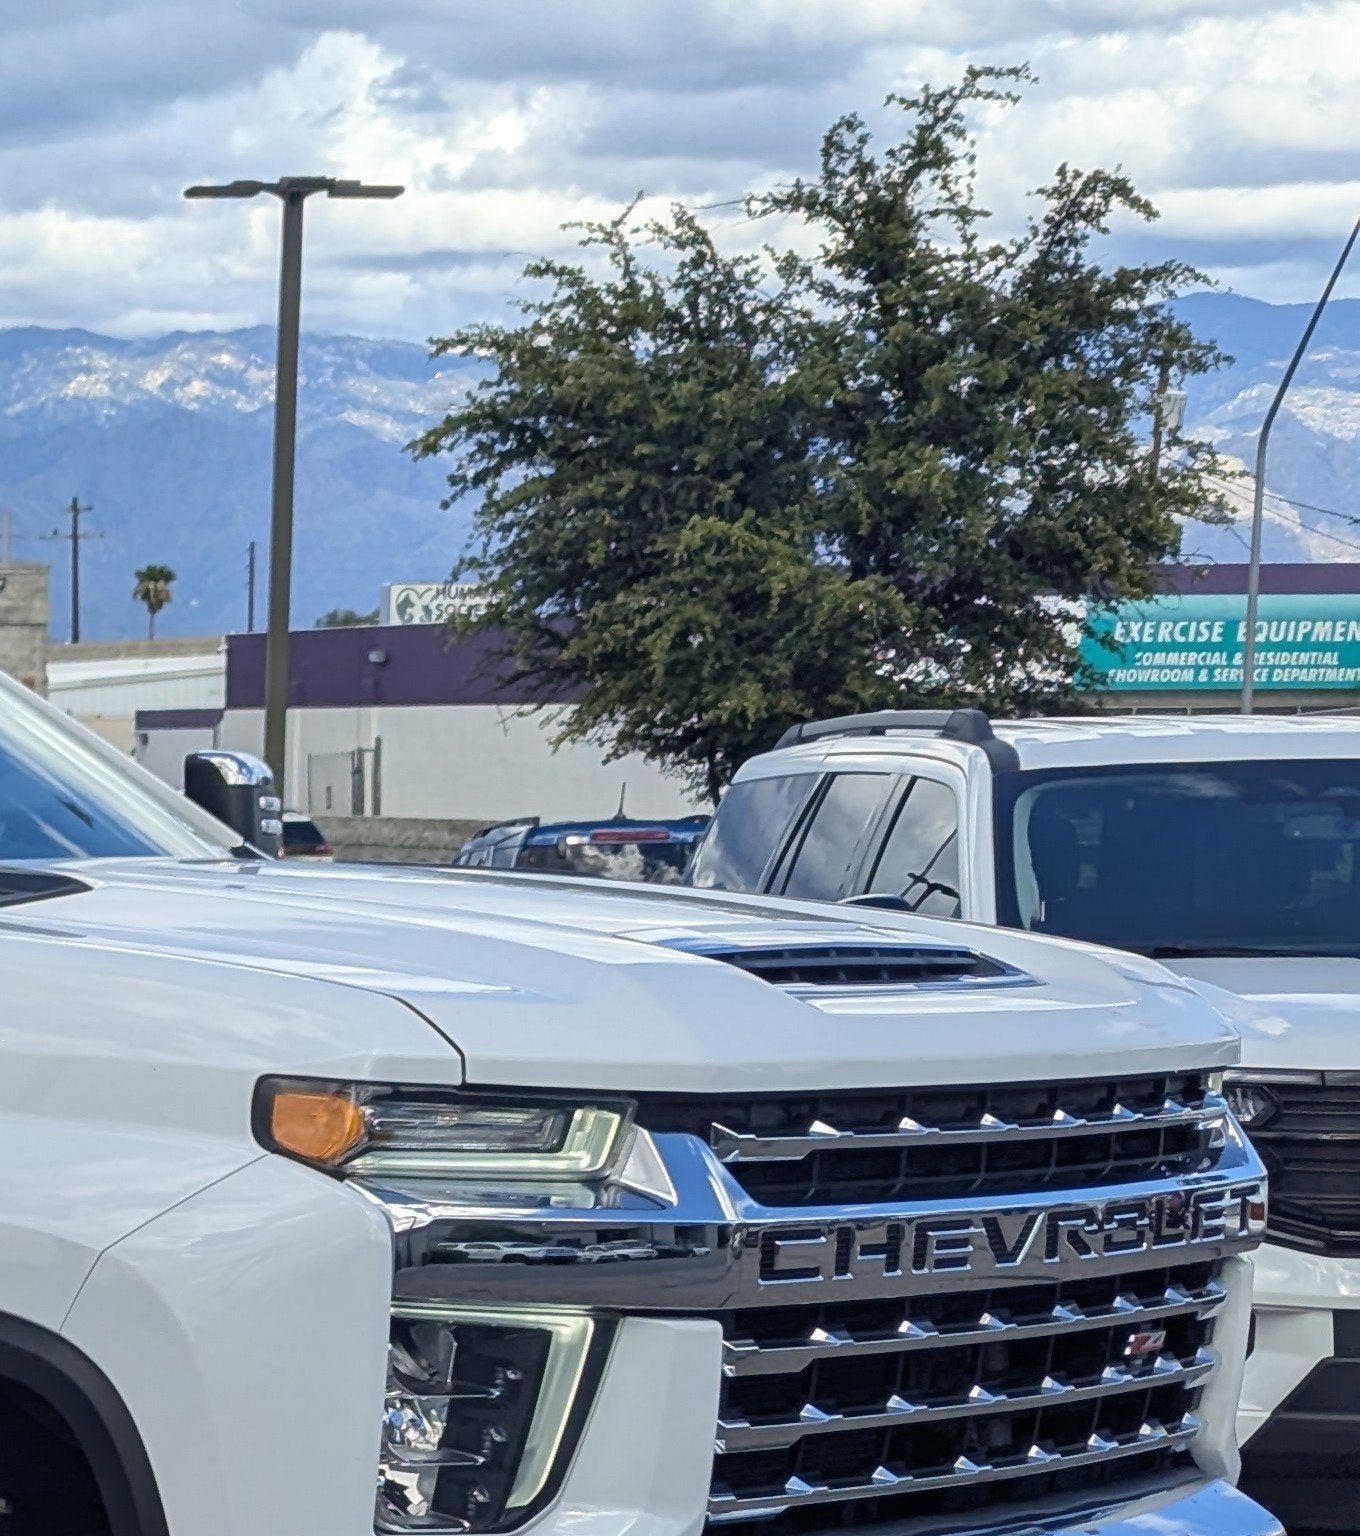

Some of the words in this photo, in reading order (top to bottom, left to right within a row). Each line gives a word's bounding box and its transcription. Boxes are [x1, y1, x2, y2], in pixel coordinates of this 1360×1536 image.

[1114, 621, 1226, 643] EXERCISE
[1198, 668, 1209, 683] &
[1212, 668, 1269, 683] SERCE
[758, 1183, 1261, 1285] CHEVROLET
